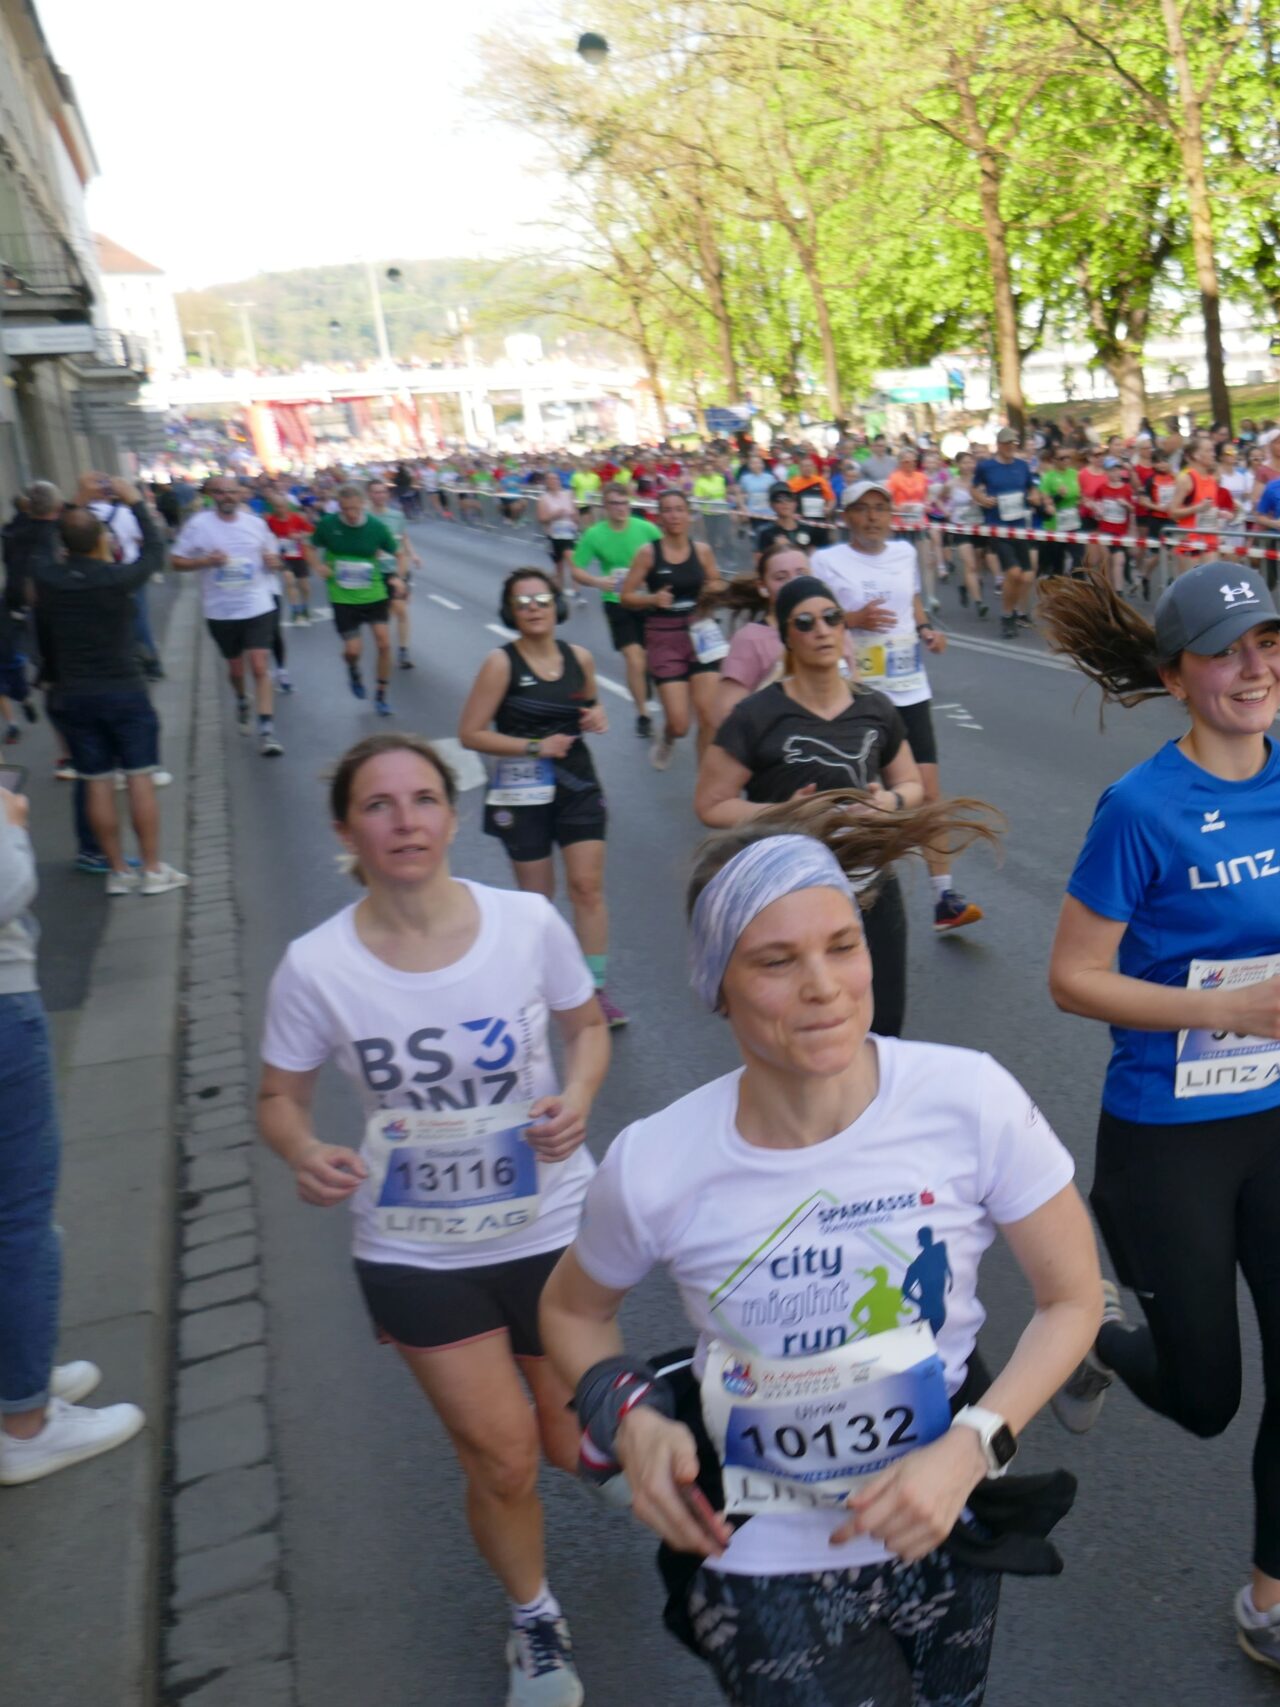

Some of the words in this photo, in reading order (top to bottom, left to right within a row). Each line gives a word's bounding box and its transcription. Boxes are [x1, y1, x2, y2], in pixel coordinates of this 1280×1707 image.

[1188, 848, 1280, 890] LINZ
[1185, 1064, 1258, 1087] LINZ
[394, 1156, 516, 1193] 13116
[386, 1214, 468, 1235] LINZ
[475, 1208, 530, 1234] AG
[817, 1192, 918, 1225] SPARKASSE
[770, 1244, 843, 1280] city
[741, 1278, 850, 1328] night
[782, 1323, 848, 1358] run
[739, 1405, 918, 1459] 10132
